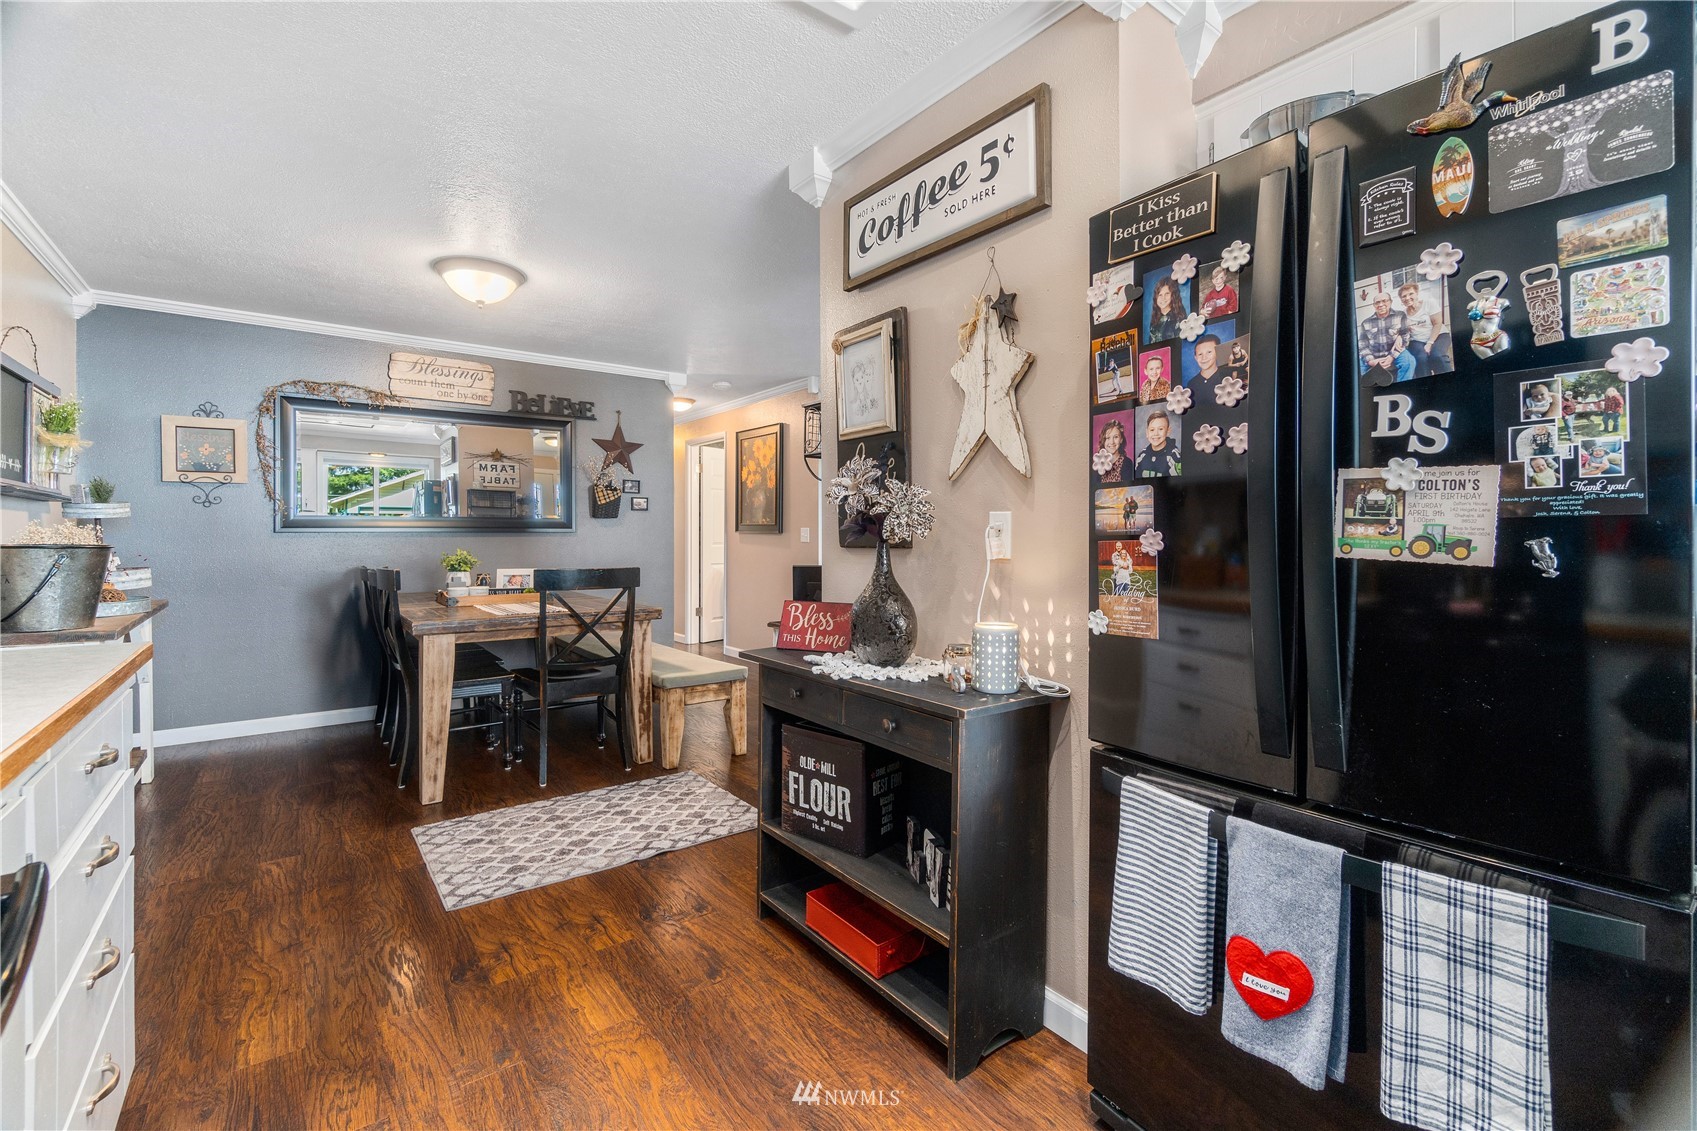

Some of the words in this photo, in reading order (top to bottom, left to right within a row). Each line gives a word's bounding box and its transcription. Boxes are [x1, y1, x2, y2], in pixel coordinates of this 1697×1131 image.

[1591, 9, 1650, 75] B
[1489, 84, 1566, 120] Whirlpool
[1553, 130, 1599, 149] Wedding
[1432, 162, 1472, 183] MAUI
[857, 208, 869, 220] HOT
[877, 193, 896, 208] FRESH
[857, 160, 972, 259] Coffee
[944, 199, 968, 218] SOLD
[972, 185, 996, 205] HERE
[1138, 204, 1144, 216] I
[1147, 192, 1180, 214] Kiss
[1113, 216, 1163, 243] Better
[1167, 200, 1208, 223] than
[1133, 239, 1139, 252] I
[1142, 225, 1184, 249] Cook
[1101, 332, 1135, 353] Baseball
[401, 357, 485, 387] Blessings
[399, 378, 427, 387] count
[430, 378, 455, 390] them
[437, 390, 454, 398] one
[457, 389, 469, 402] by
[471, 393, 488, 401] one
[1437, 469, 1452, 478] join
[1467, 468, 1480, 476] for
[1414, 492, 1438, 500] FIRST
[1441, 492, 1482, 500] BIRTHDAY
[1418, 479, 1480, 491] COLTON'S
[1570, 479, 1606, 492] Thank
[1606, 478, 1635, 494] you!
[788, 603, 834, 630] Bless
[783, 634, 801, 642] THIS
[805, 627, 847, 649] Home
[800, 755, 816, 771] OLDE
[821, 761, 836, 777] MILL
[873, 777, 888, 796] BEST
[890, 772, 902, 789] FOR
[789, 770, 852, 823] FLOUR
[1270, 988, 1286, 996] you
